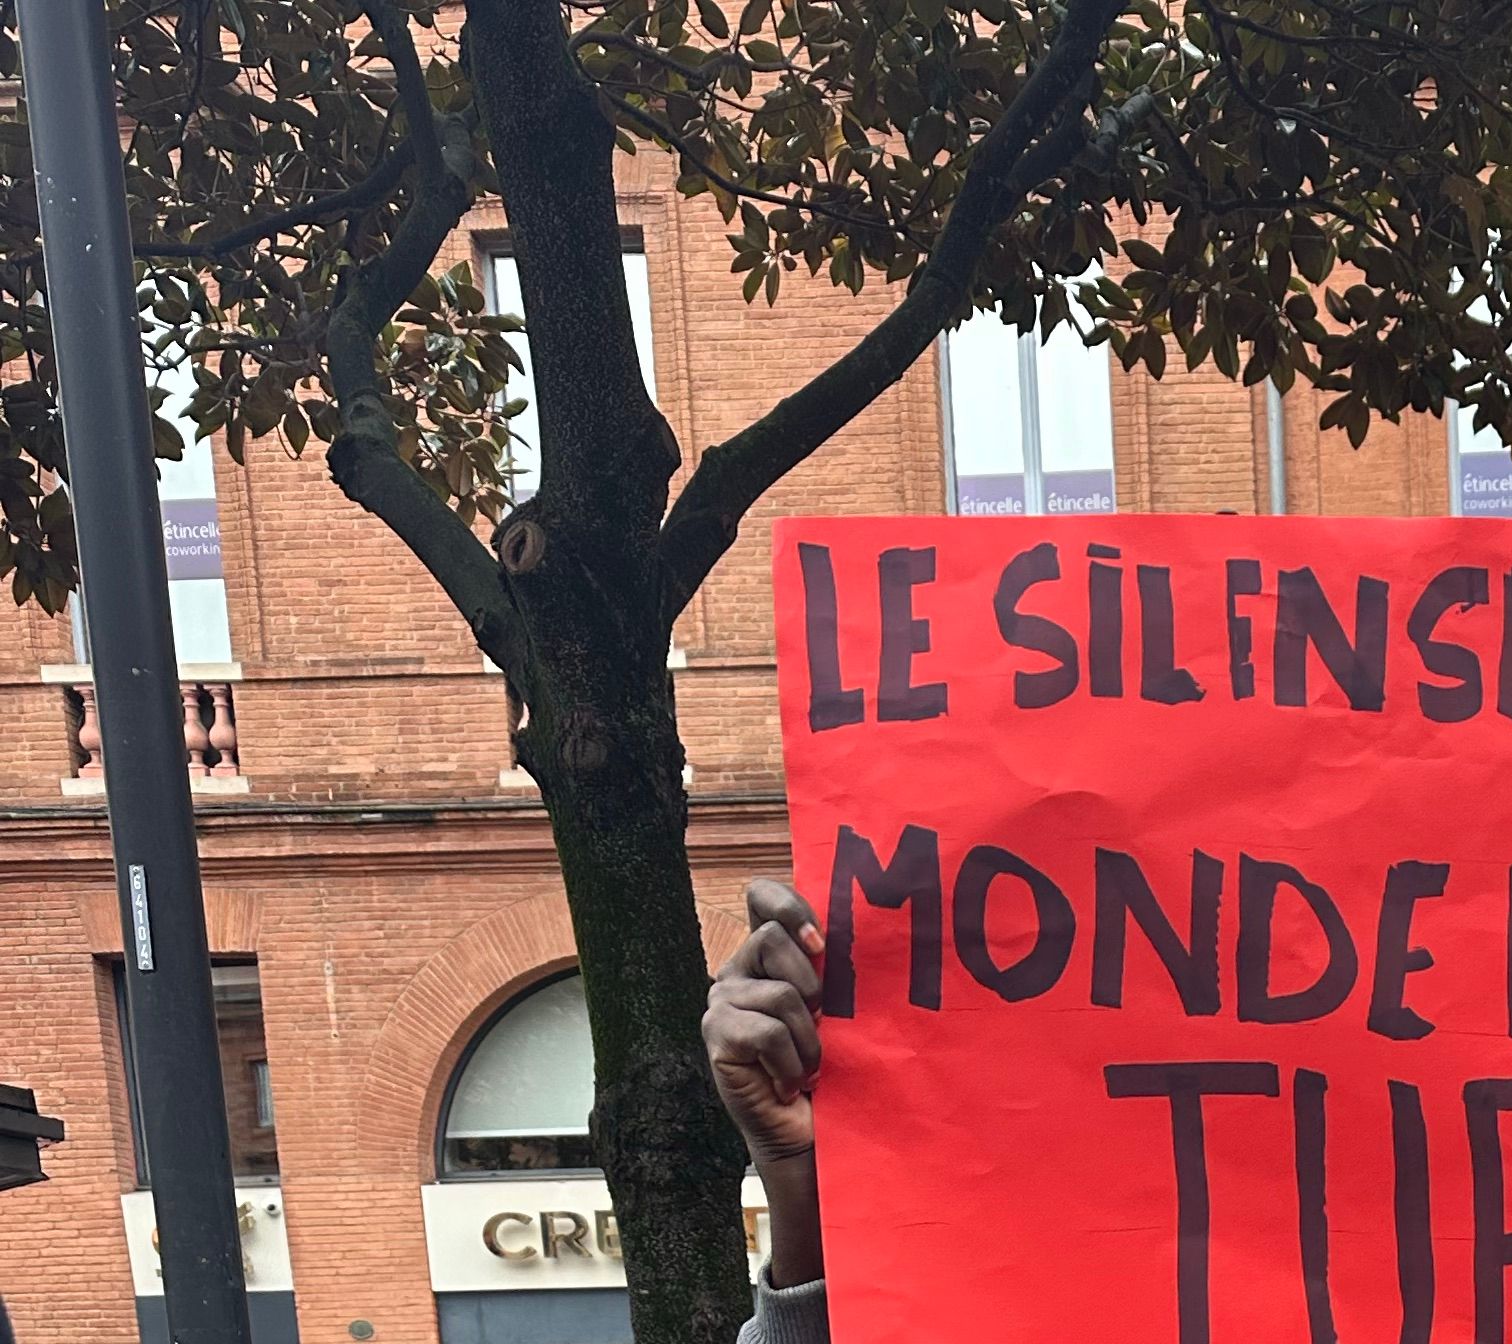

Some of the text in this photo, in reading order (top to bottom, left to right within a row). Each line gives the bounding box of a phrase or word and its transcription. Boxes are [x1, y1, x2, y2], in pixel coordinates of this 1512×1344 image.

[960, 496, 1023, 515] étincelle
[1047, 493, 1111, 512] étincelle
[166, 543, 220, 556] coworkin
[799, 543, 948, 732] LE
[821, 824, 1451, 1041] MONDE
